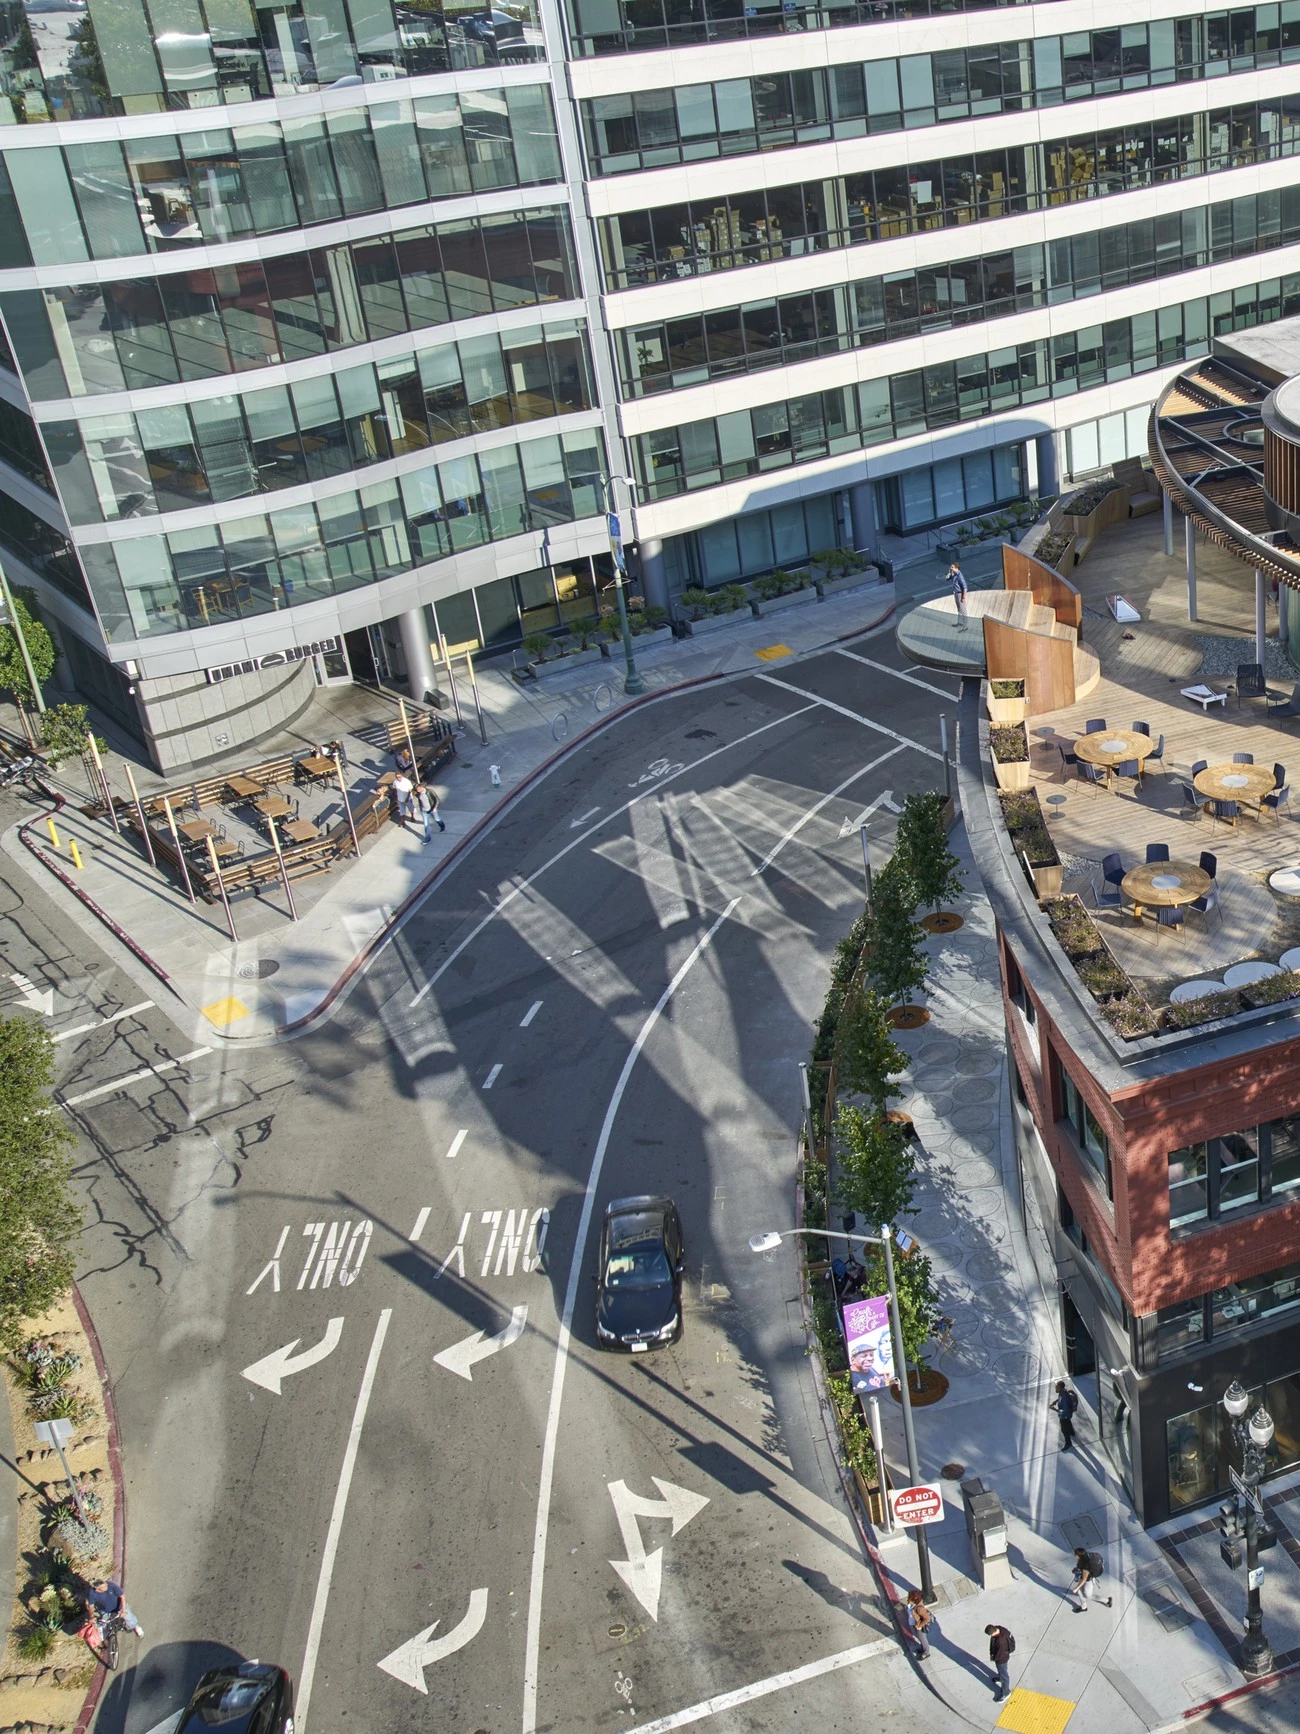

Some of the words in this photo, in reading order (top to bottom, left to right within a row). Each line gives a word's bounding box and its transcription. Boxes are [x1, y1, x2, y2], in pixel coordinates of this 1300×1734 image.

[211, 658, 260, 682] UMAMI
[285, 638, 336, 661] BURGER
[245, 1219, 374, 1295] ONLY
[433, 1207, 551, 1279] ONLY
[899, 1496, 912, 1505] DO
[915, 1491, 934, 1501] NOT
[903, 1508, 935, 1520] ENTER
